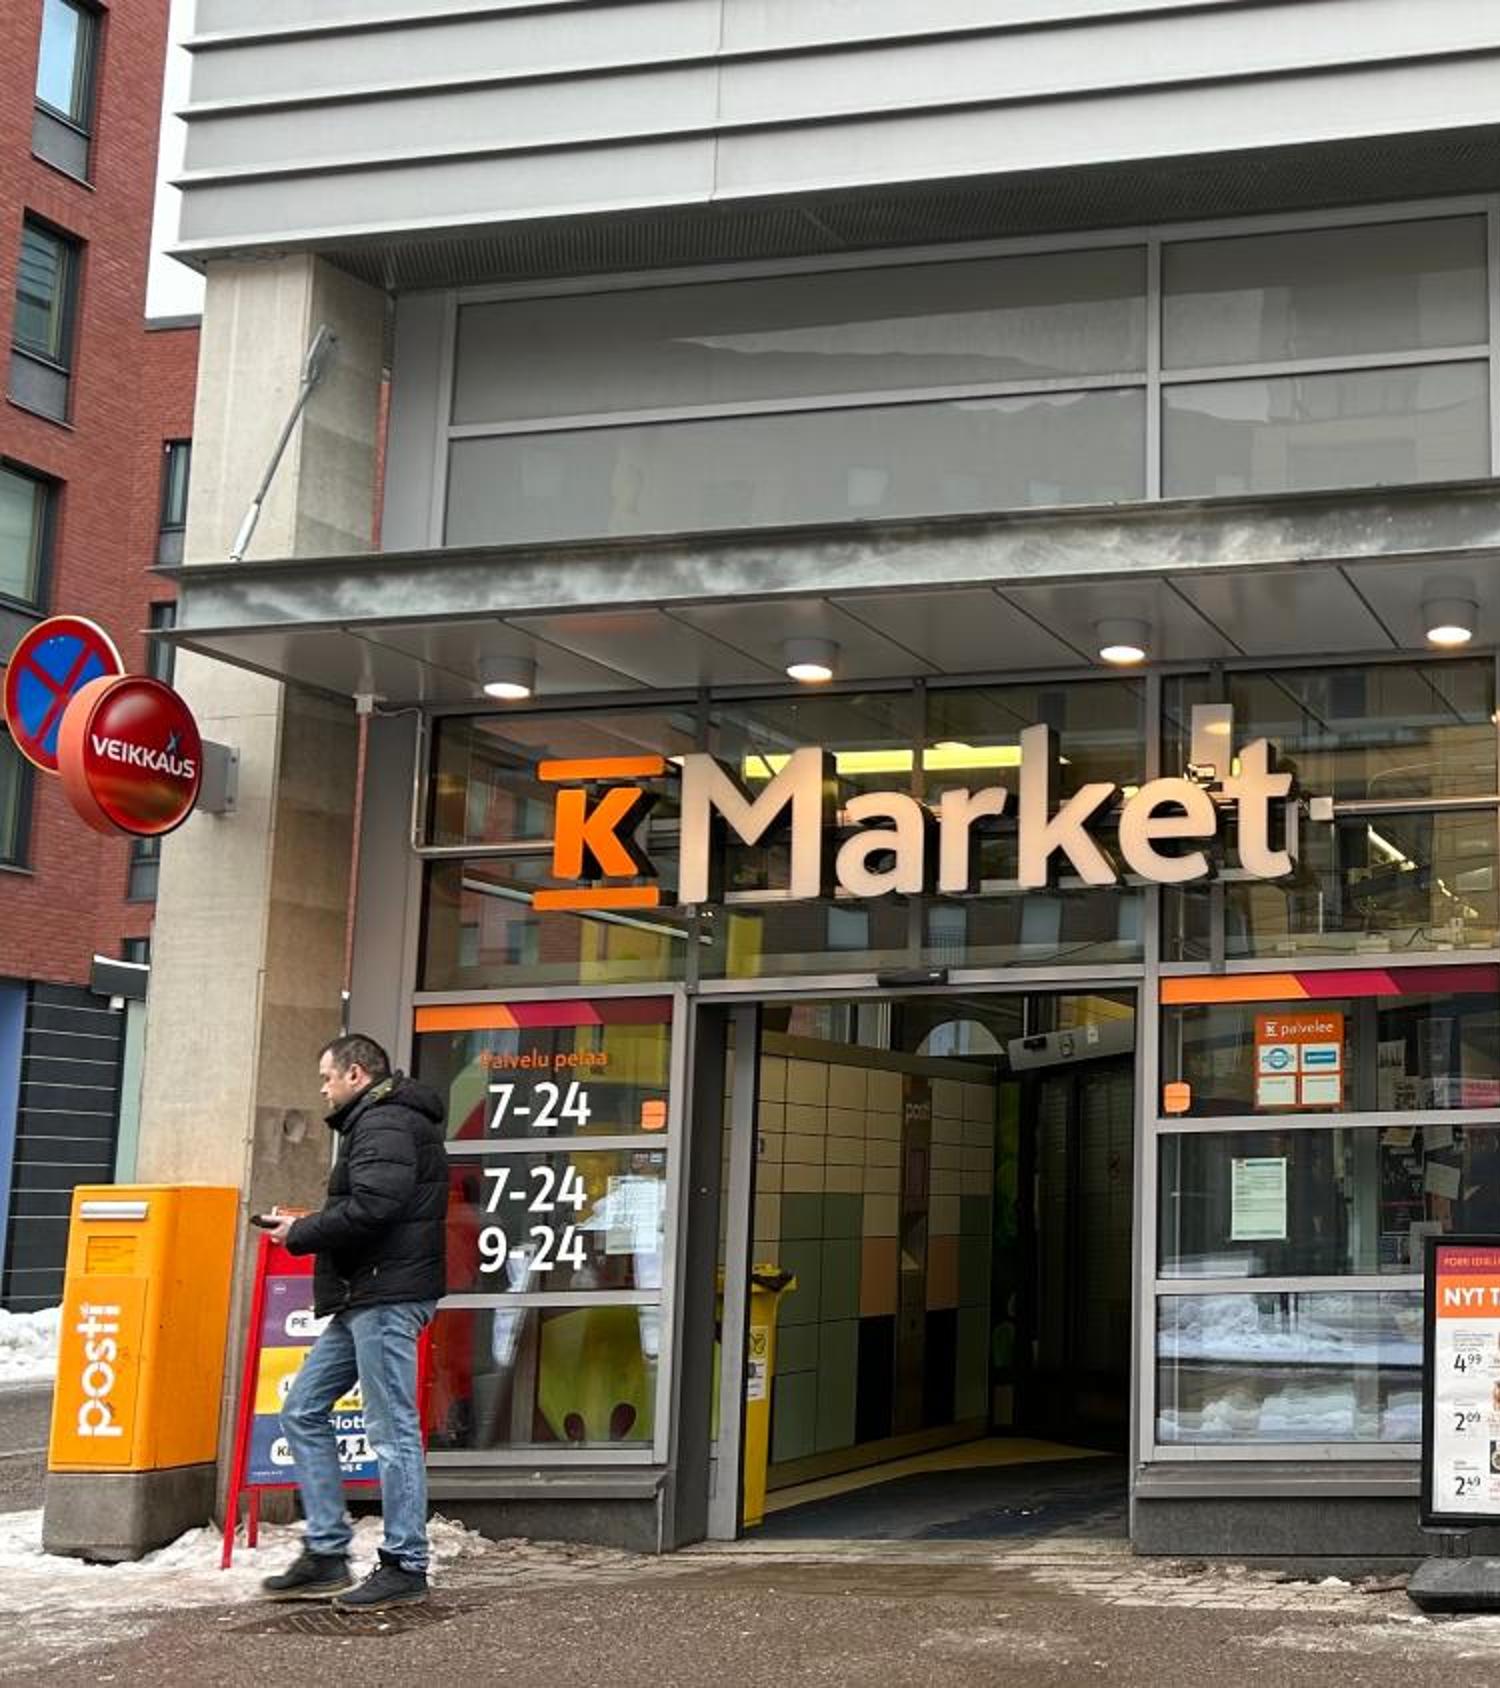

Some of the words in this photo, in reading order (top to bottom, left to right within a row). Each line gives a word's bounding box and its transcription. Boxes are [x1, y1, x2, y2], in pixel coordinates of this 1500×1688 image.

[91, 733, 196, 780] VEIKKAUS
[678, 722, 1294, 905] Market
[1281, 1019, 1335, 1037] palvelee
[488, 1081, 592, 1129] 7-24
[483, 1165, 587, 1213] 7-24
[477, 1224, 587, 1274] 9-24
[1444, 1287, 1484, 1307] NYT
[76, 1304, 124, 1436] posti
